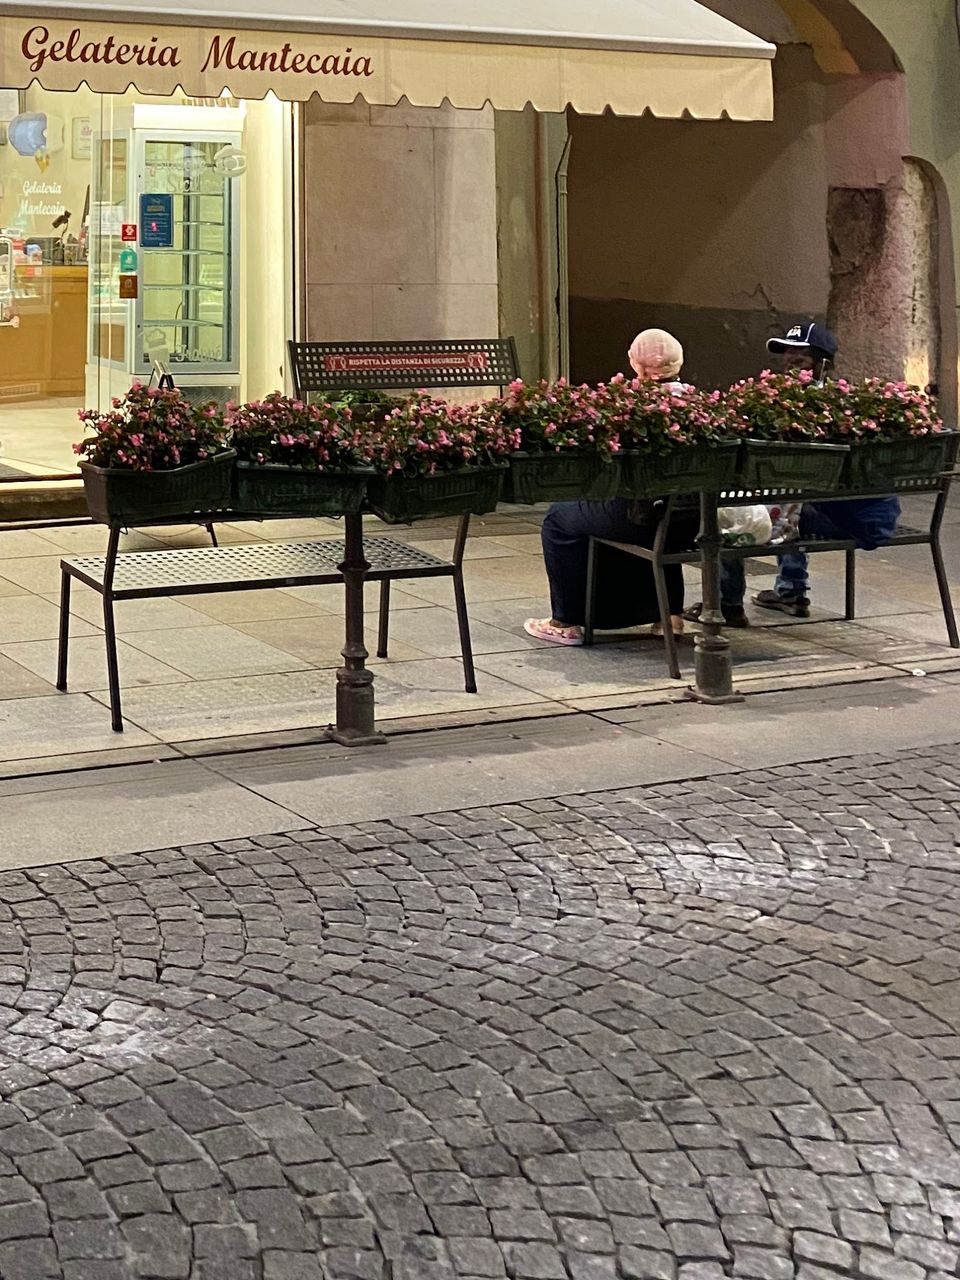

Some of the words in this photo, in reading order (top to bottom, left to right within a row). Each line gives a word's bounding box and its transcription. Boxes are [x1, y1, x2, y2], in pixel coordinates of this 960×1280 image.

[21, 25, 182, 72] Gelateria
[200, 35, 375, 77] Mantecaia
[22, 180, 62, 196] Gelateria
[18, 199, 65, 217] Mantecaia
[348, 358, 381, 366] RISPETTA
[391, 357, 423, 365] DISTANZA
[423, 357, 431, 365] DI
[431, 356, 466, 364] SICUREZZA
